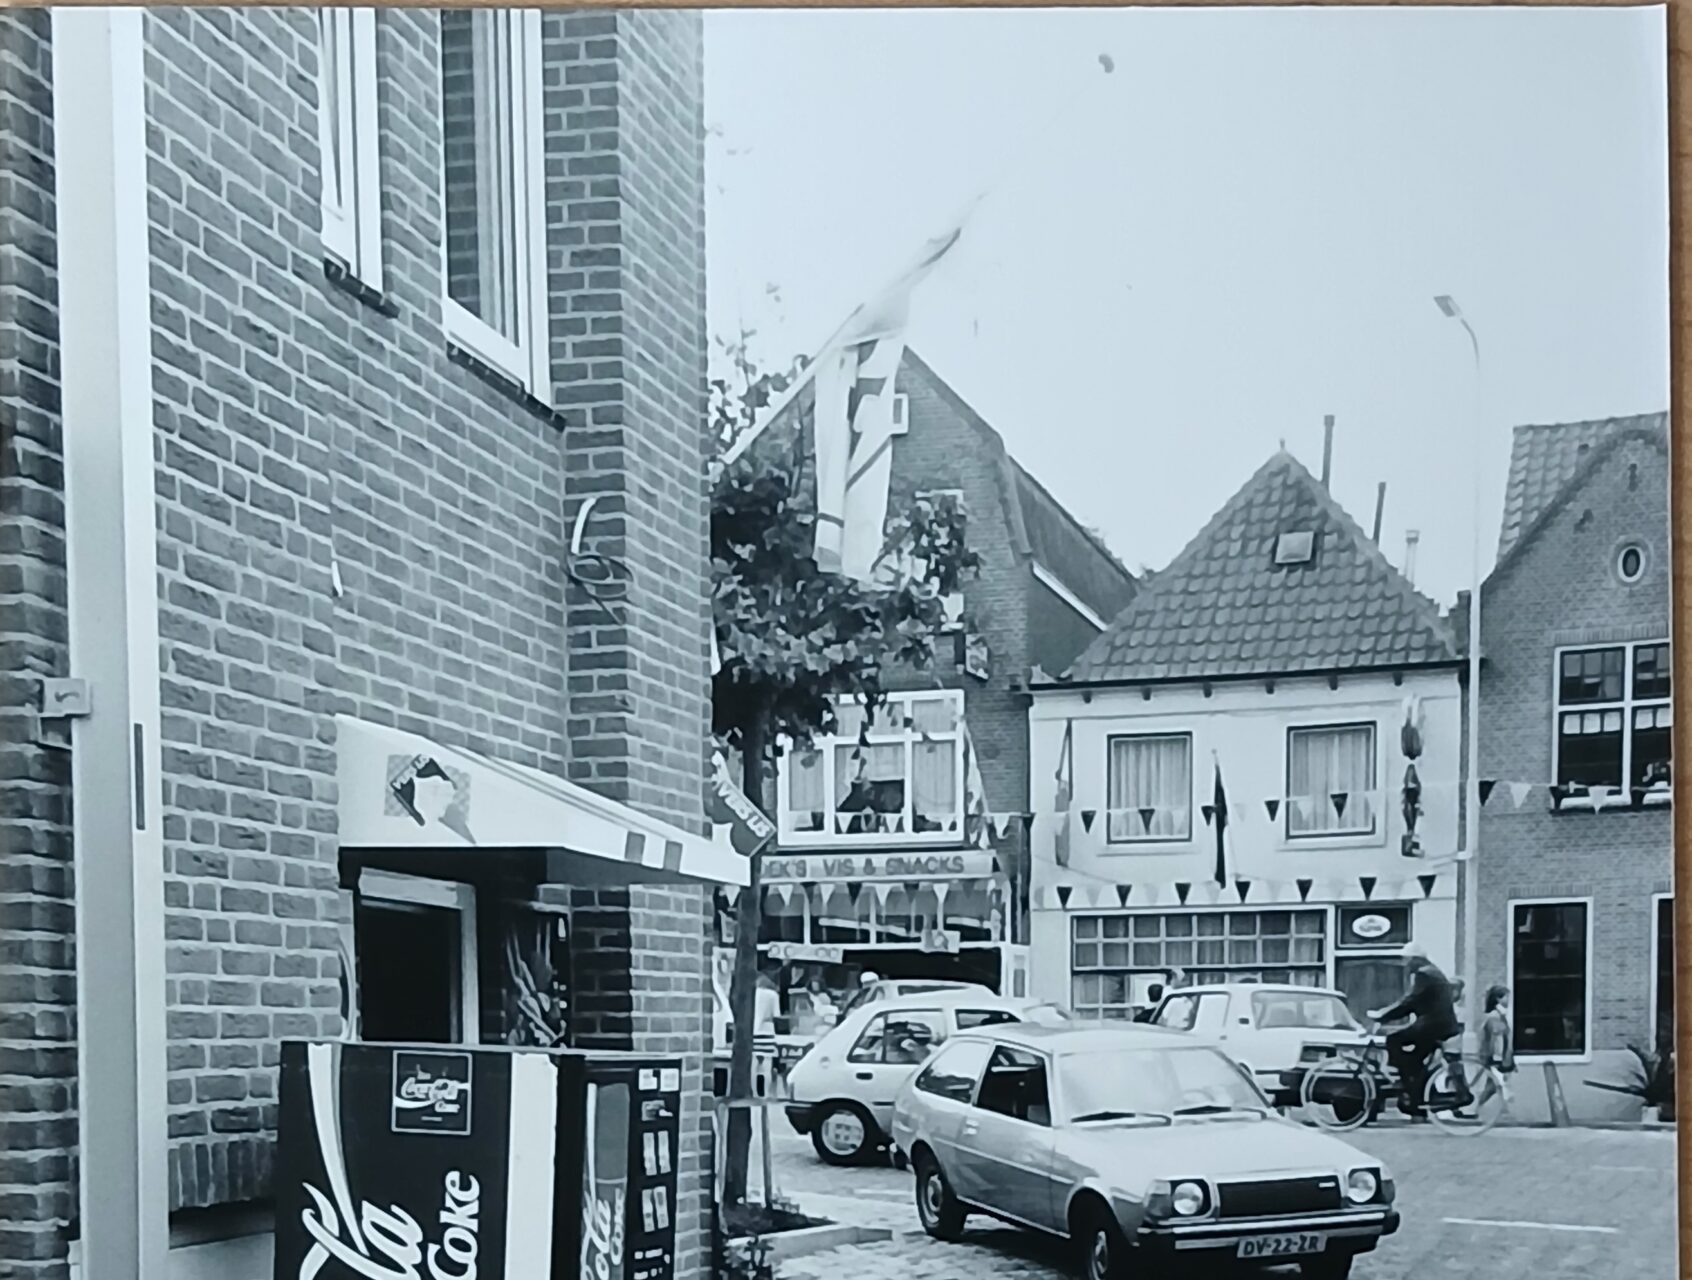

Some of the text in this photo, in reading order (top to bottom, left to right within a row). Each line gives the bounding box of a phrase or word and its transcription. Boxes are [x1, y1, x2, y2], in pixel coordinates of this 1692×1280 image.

[822, 858, 854, 876] VIS
[884, 856, 965, 875] SNACKS
[1243, 1233, 1320, 1257] DV-22-ZR
